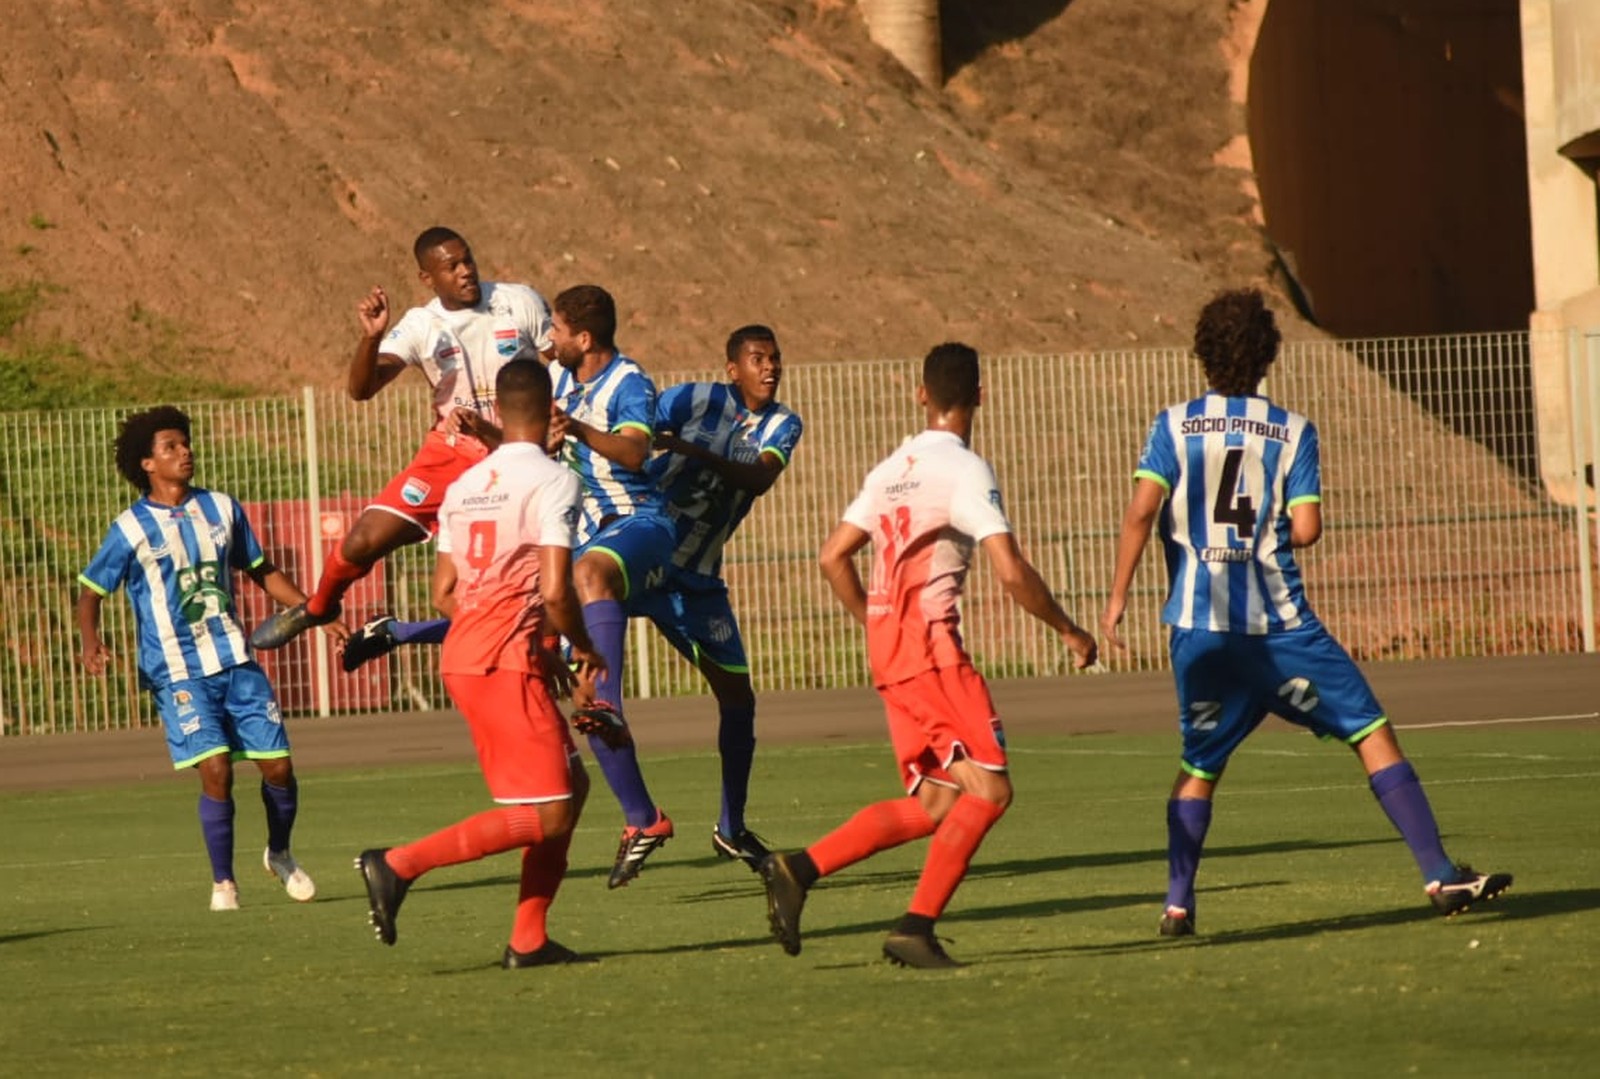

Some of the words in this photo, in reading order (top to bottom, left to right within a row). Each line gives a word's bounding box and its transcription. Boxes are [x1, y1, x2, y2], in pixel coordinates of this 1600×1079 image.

[1181, 413, 1226, 435] SÓCIO
[1231, 417, 1291, 443] PITBULL
[1213, 448, 1257, 539] 4
